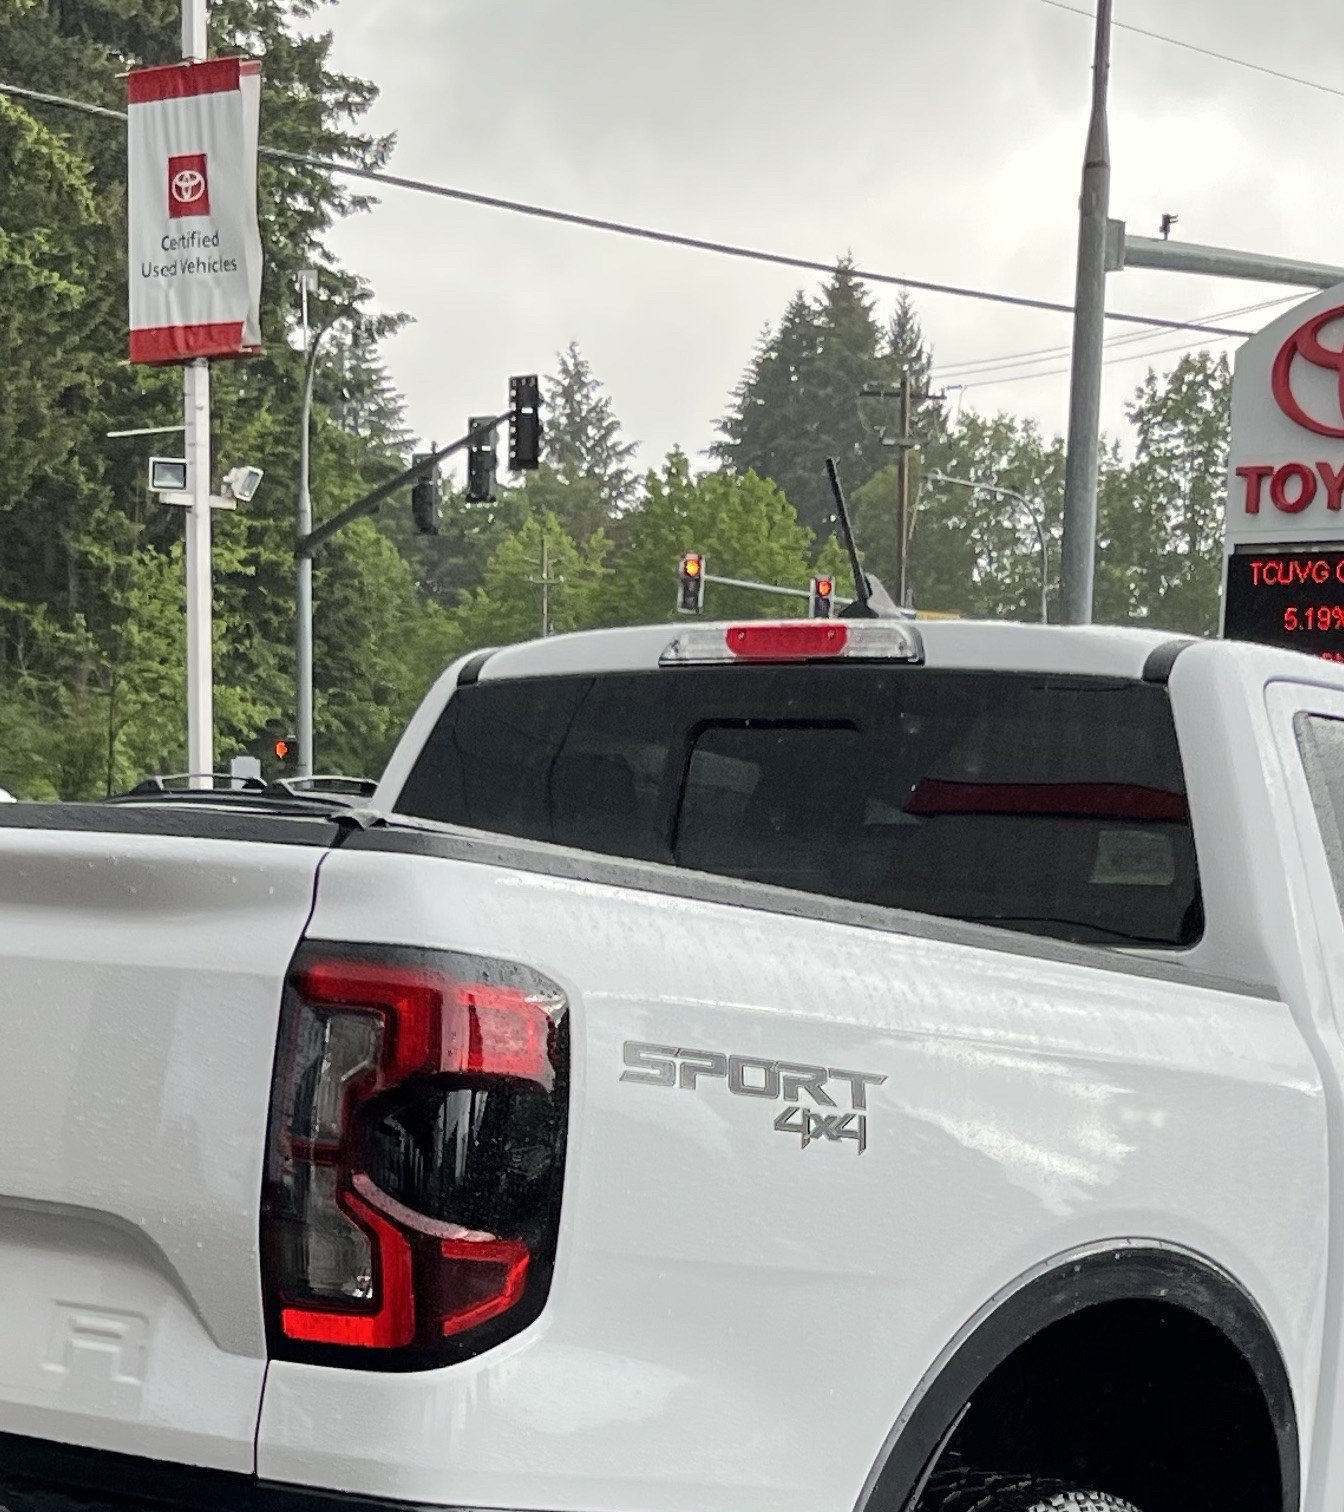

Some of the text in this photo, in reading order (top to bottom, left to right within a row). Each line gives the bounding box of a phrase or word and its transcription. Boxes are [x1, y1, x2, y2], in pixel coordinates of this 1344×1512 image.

[161, 230, 219, 252] Certified
[141, 256, 237, 278] Used Vehicles
[1249, 560, 1330, 586] TCUVG
[618, 1039, 889, 1112] SPORT
[773, 1105, 867, 1156] 4x4
